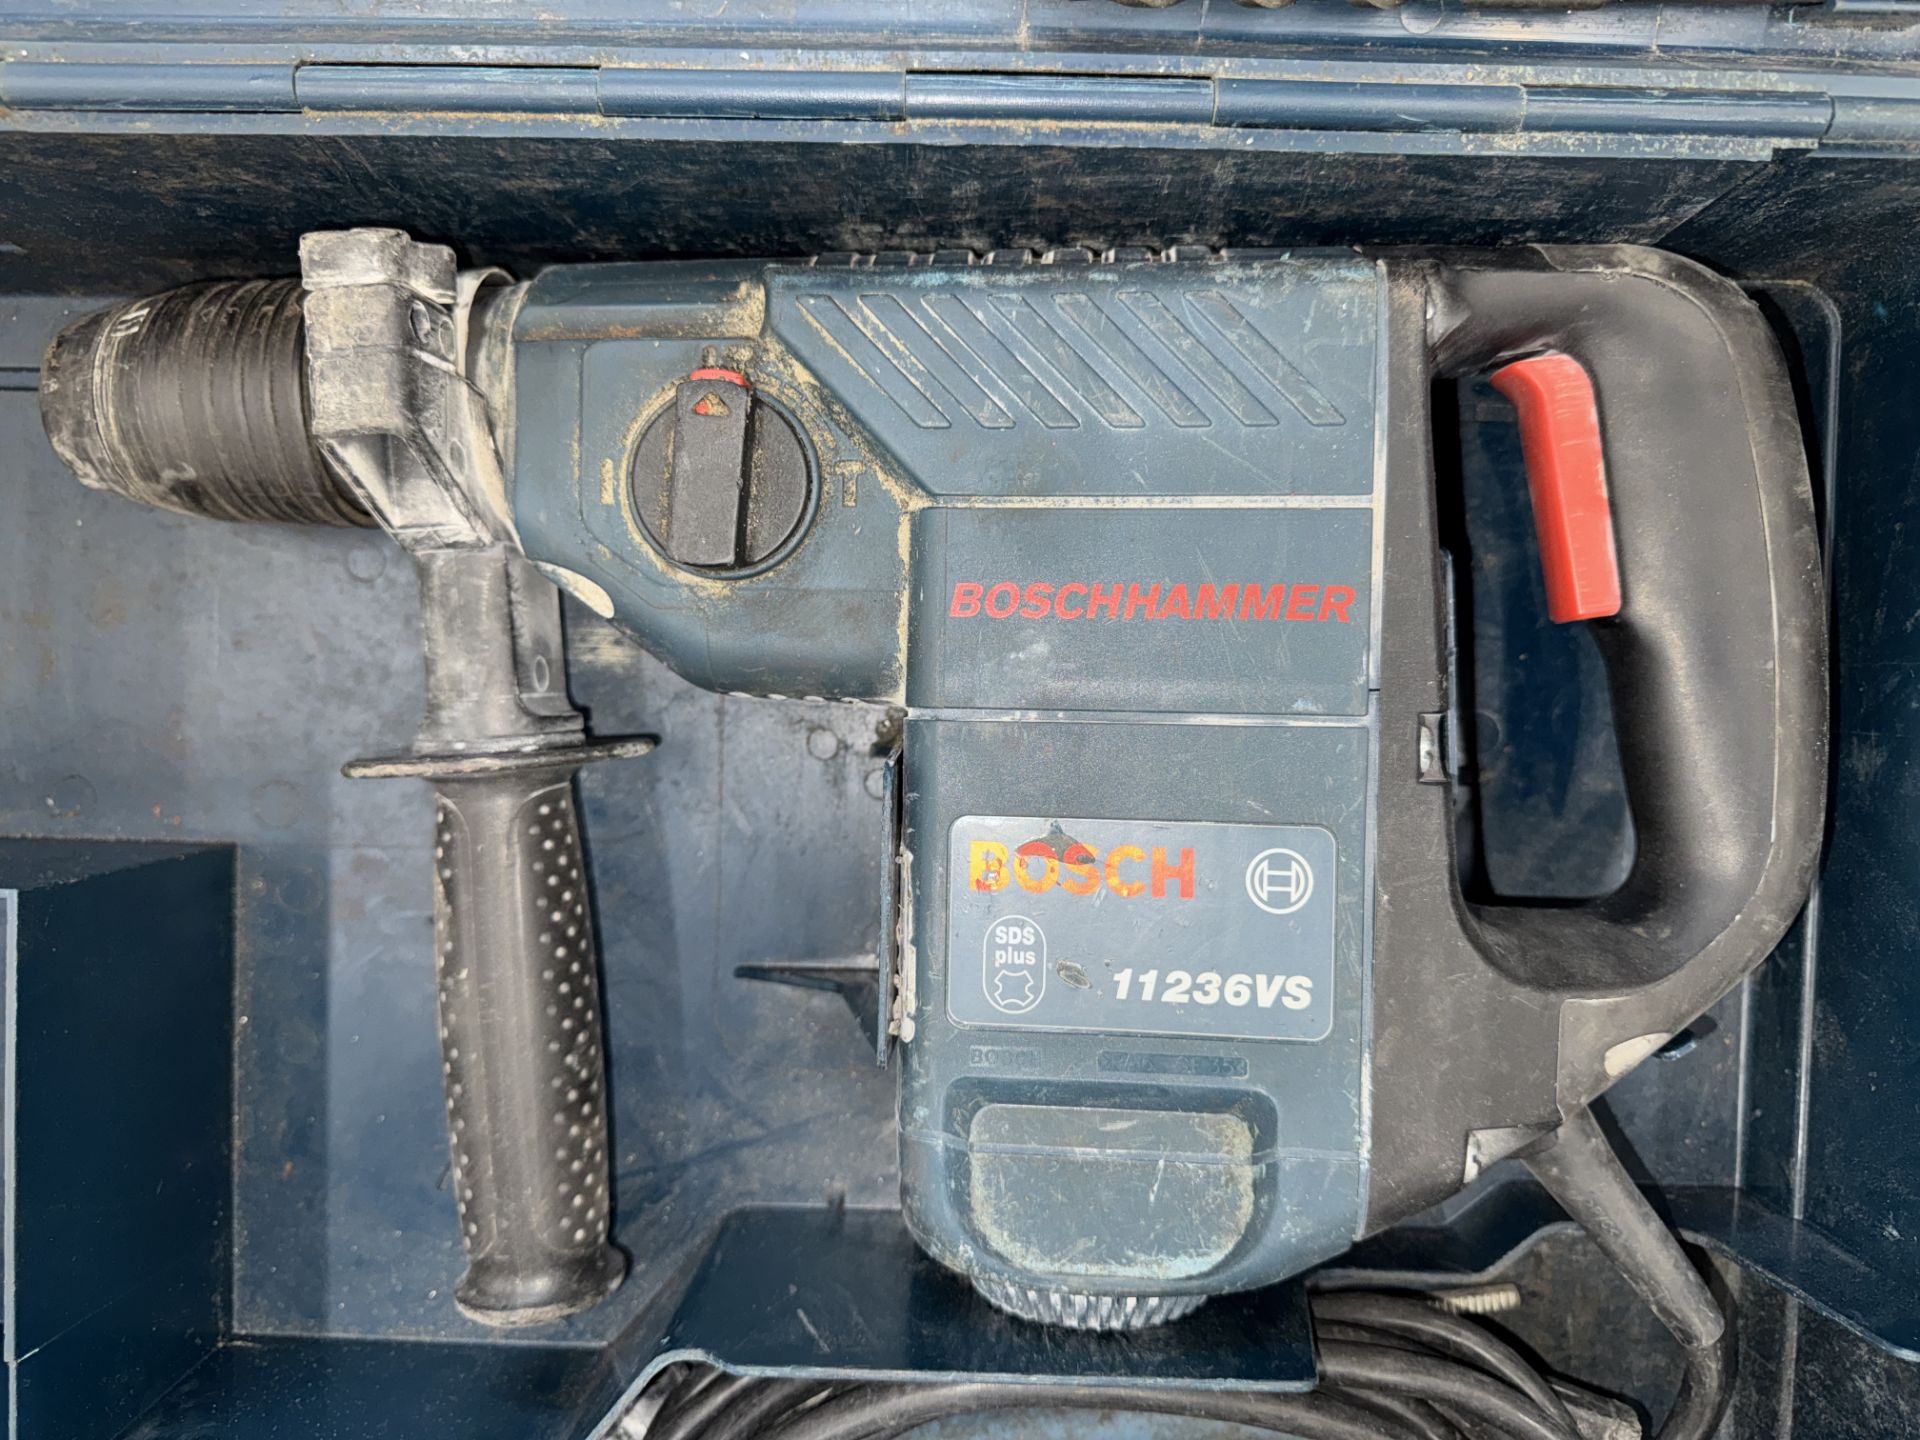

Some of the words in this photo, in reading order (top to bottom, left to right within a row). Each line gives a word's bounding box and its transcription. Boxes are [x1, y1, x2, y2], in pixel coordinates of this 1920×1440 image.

[949, 581, 1357, 623] BOSCHHAMMER
[968, 839, 1196, 900] BOSCH
[994, 926, 1036, 946] SDS
[995, 948, 1036, 967] plus
[1112, 967, 1314, 1010] 11236VS
